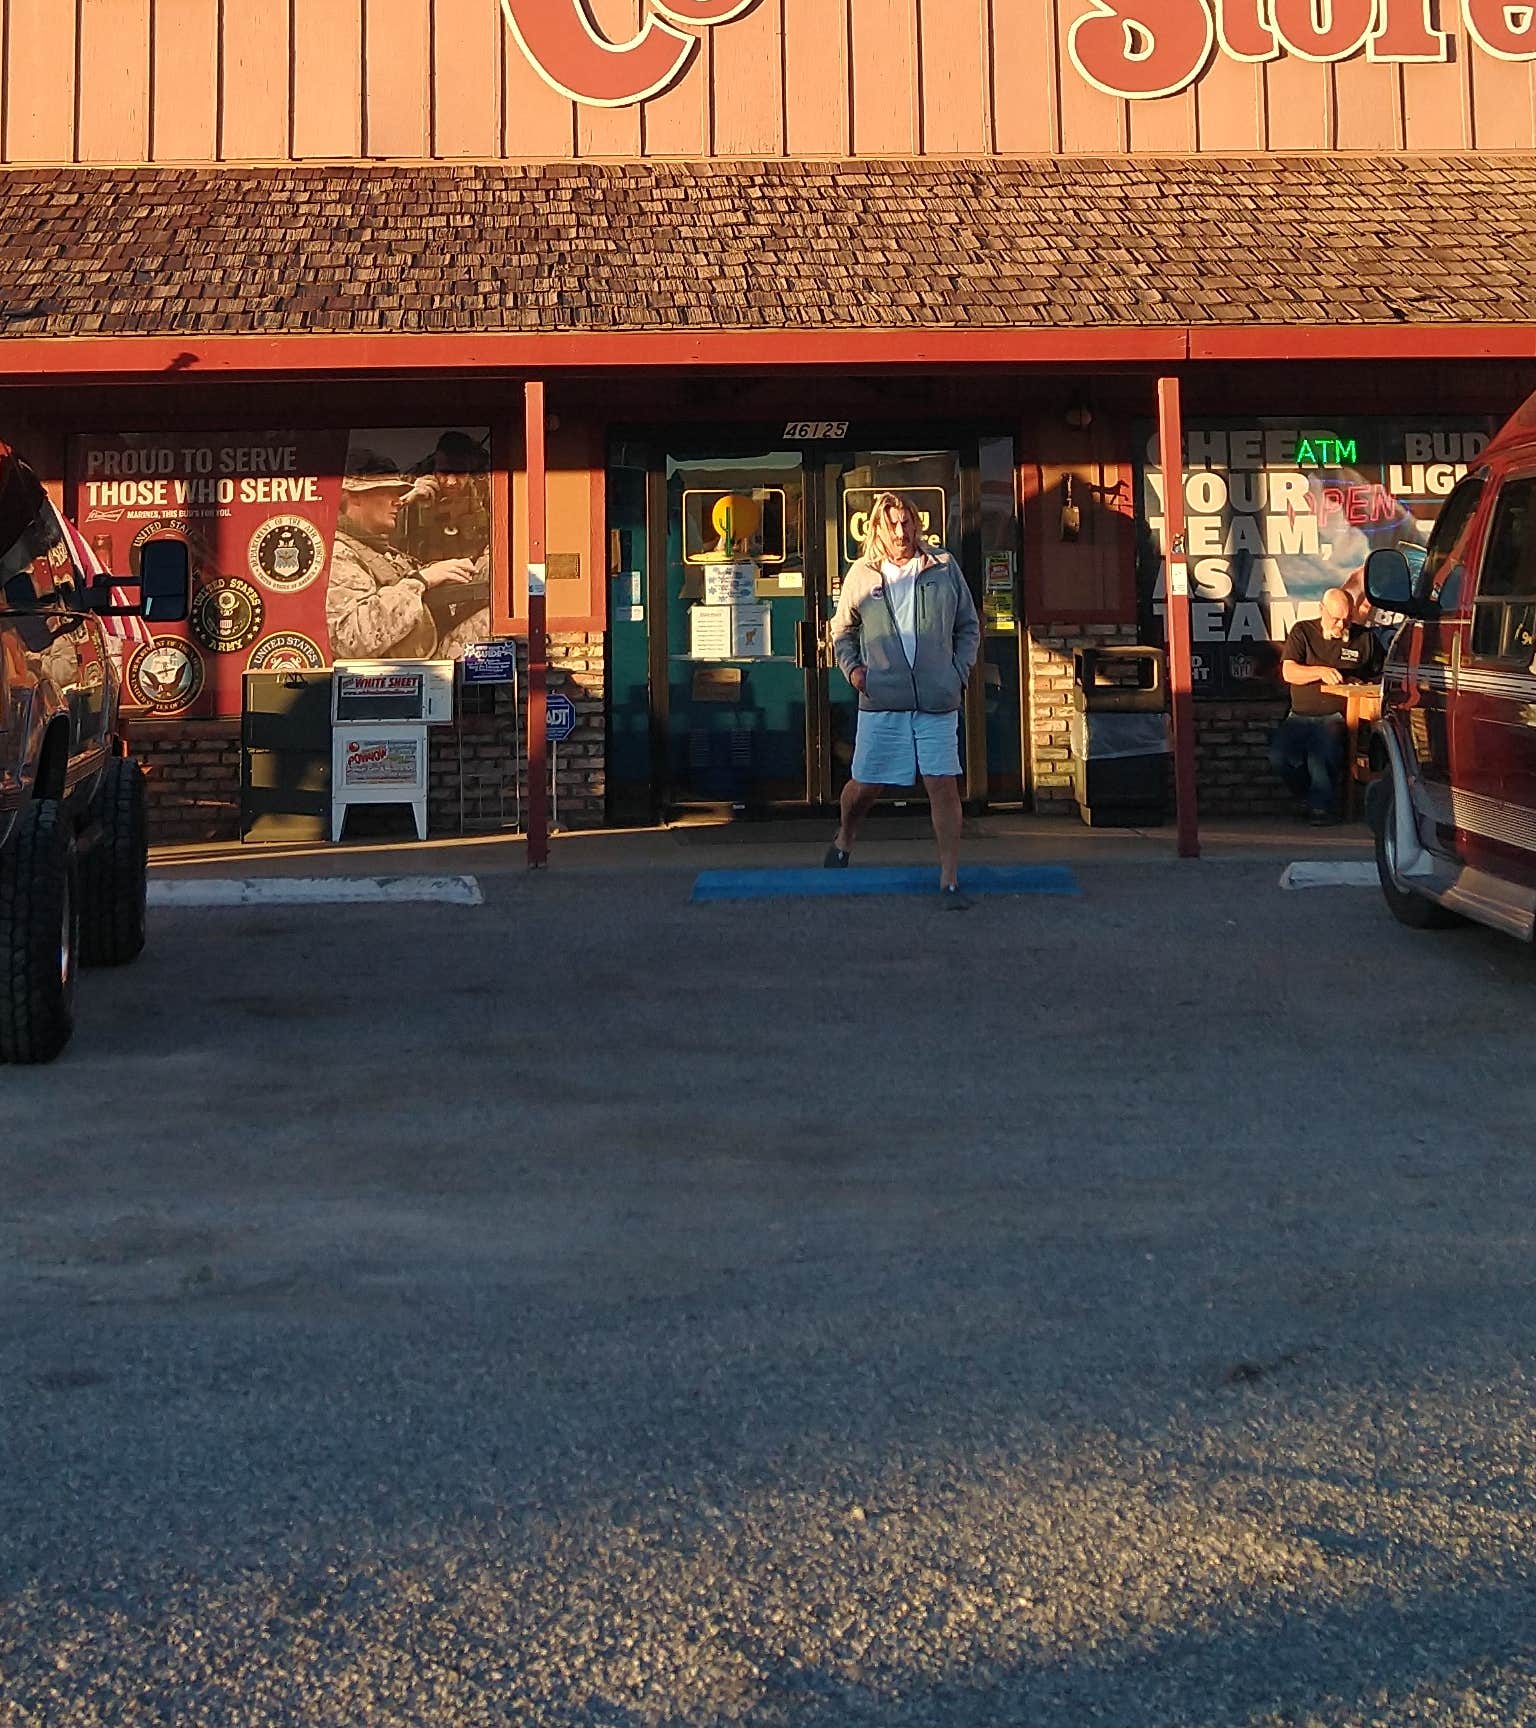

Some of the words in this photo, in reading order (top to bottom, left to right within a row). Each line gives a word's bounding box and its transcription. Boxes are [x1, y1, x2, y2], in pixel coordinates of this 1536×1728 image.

[785, 422, 846, 438] 46125
[87, 448, 173, 475] PROUD
[179, 447, 213, 473] TO
[219, 446, 297, 472] SERVE
[1296, 439, 1358, 464] ATM
[1405, 432, 1490, 463] BUD
[86, 480, 168, 506] THOSE
[174, 478, 234, 504] WHO
[240, 477, 323, 503] SERVE.
[163, 510, 178, 519] THIS
[216, 508, 232, 517] YOU.
[133, 521, 162, 547] UNITED
[1245, 558, 1289, 598] A
[193, 578, 225, 606] UNITED
[229, 578, 262, 606] STATES
[208, 639, 243, 652] ARMY
[253, 637, 285, 663] UNITED
[287, 636, 318, 663] STATES
[355, 677, 386, 689] WHITE
[389, 676, 419, 688] SHEET
[546, 709, 569, 726] ADT
